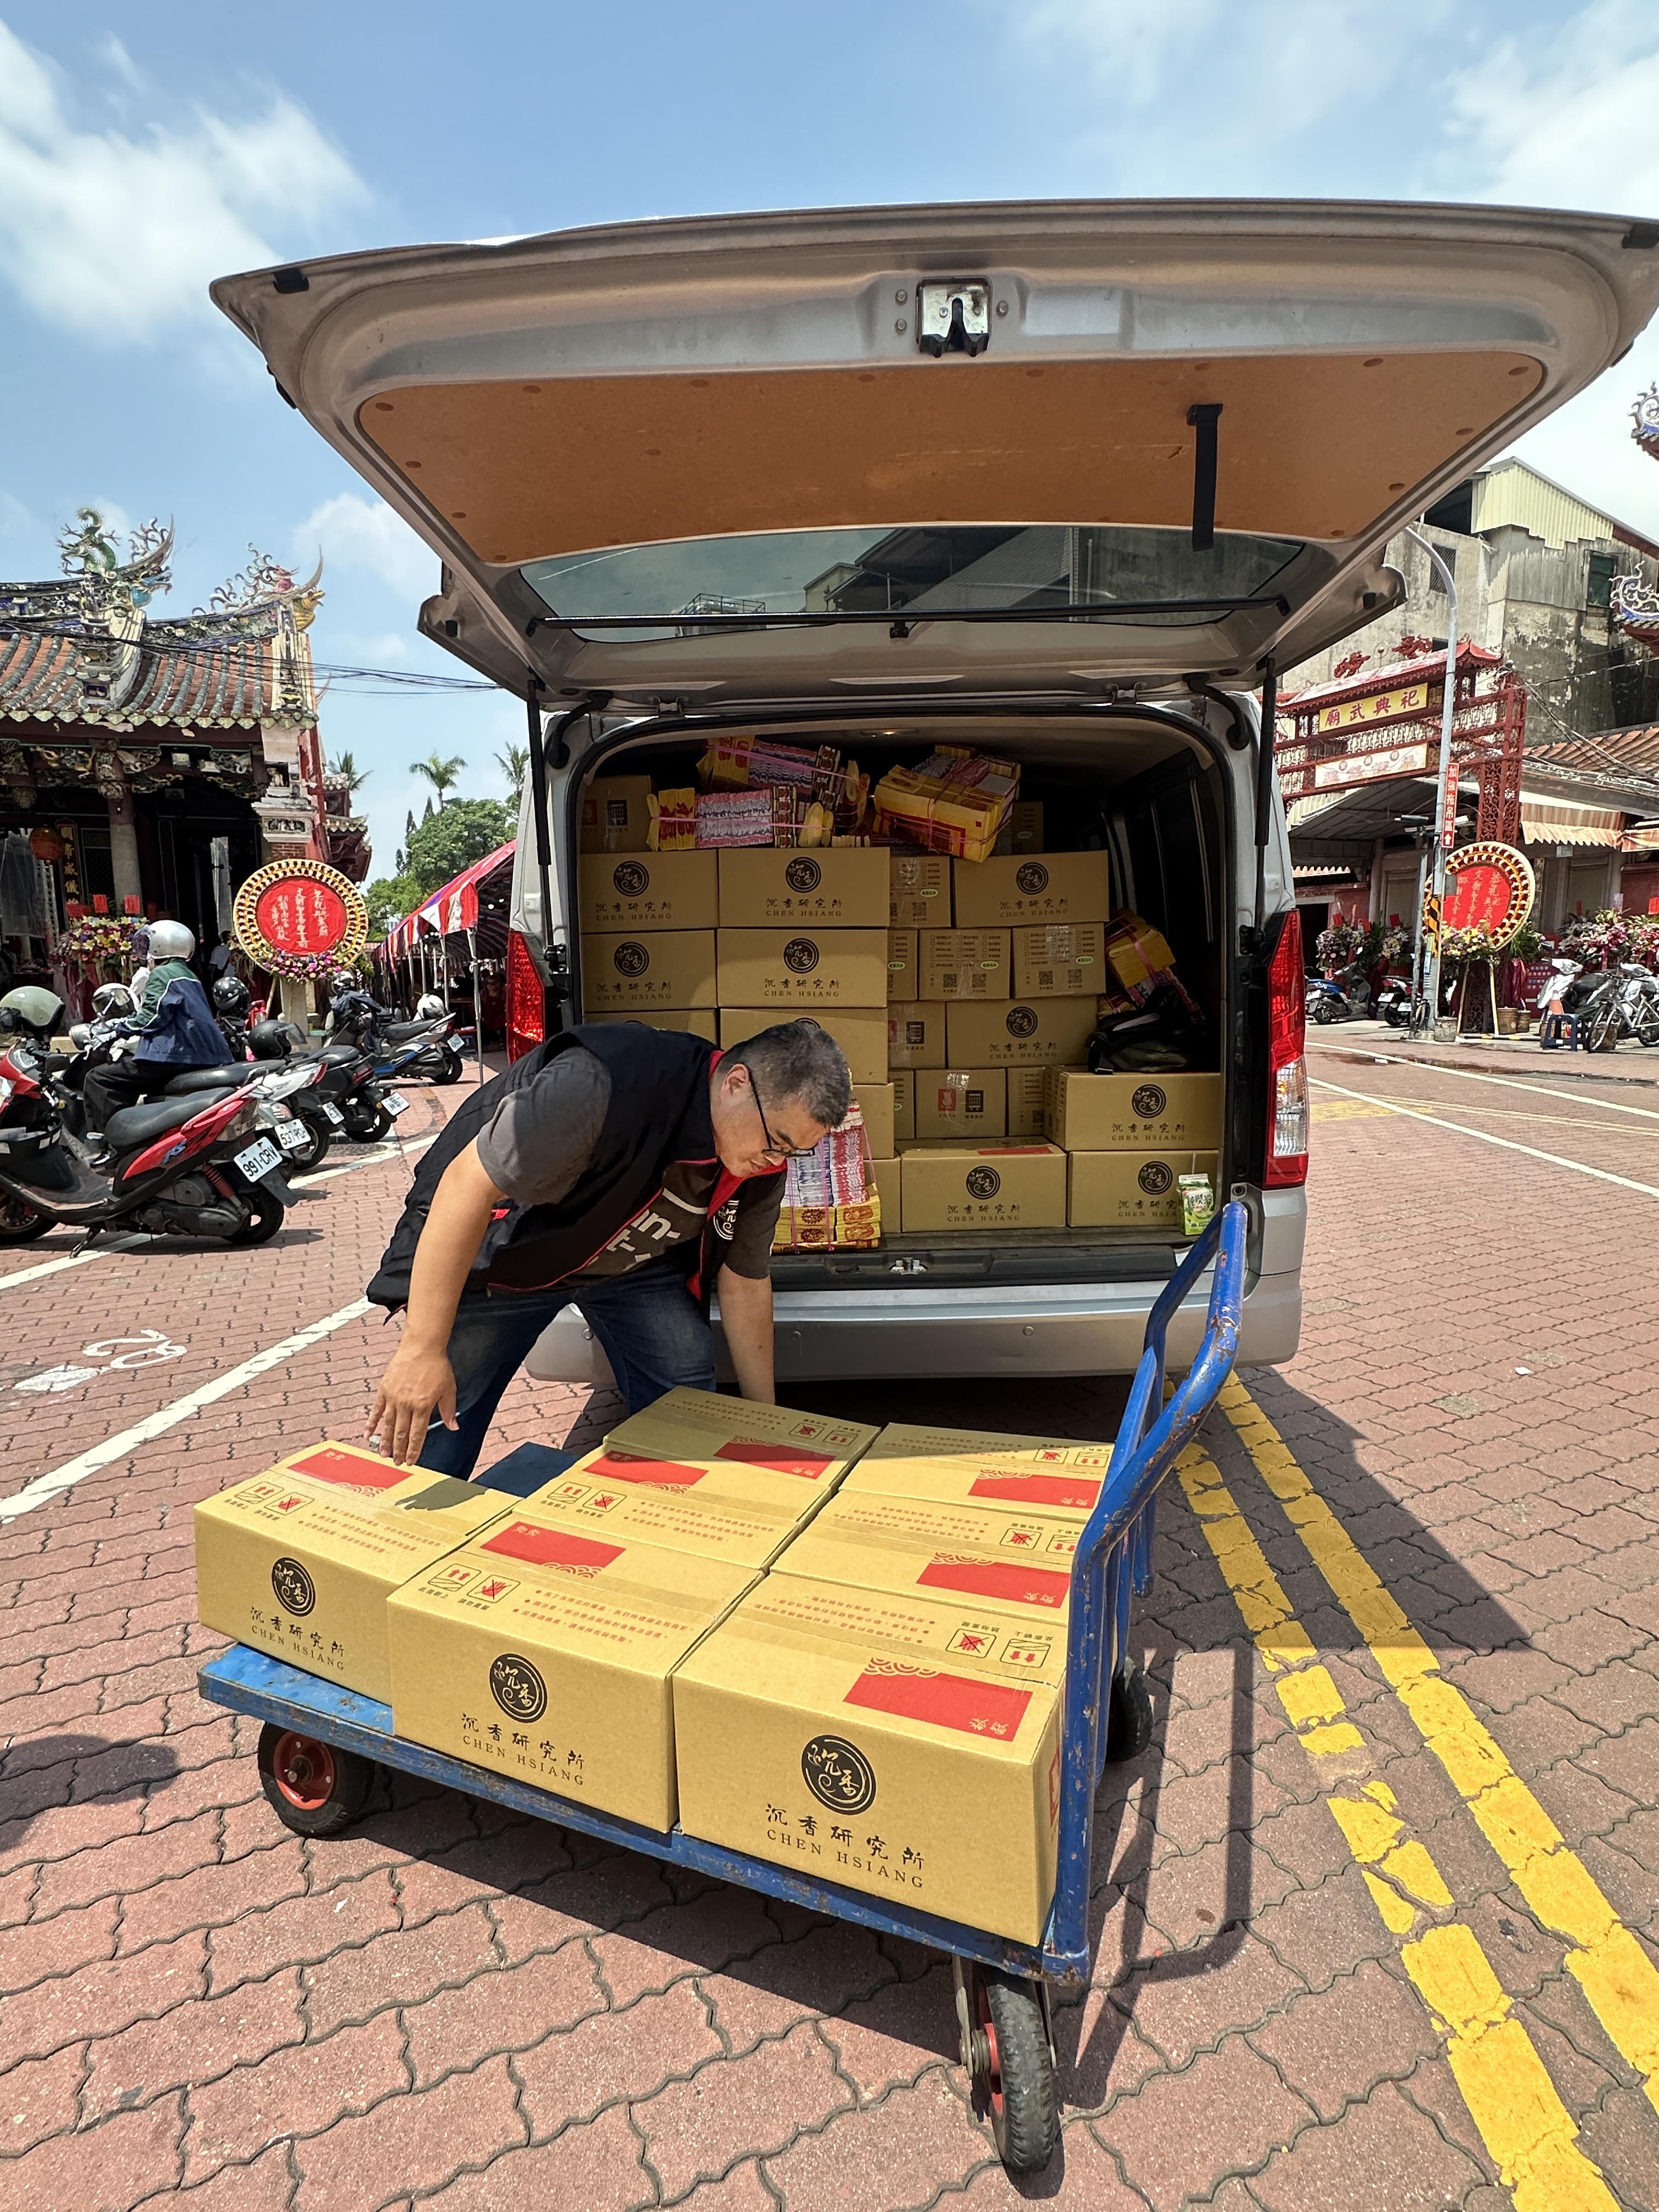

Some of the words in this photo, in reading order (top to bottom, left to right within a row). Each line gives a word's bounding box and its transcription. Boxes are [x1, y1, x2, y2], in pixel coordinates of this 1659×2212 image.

[595, 901, 672, 913] 沉香研究所
[766, 898, 843, 909] 沉香研究所
[1000, 898, 1069, 910] 沉香研究所
[596, 981, 672, 992] 沉香研究所
[764, 978, 839, 989] 沉香研究所
[597, 993, 624, 1001] CHEN
[798, 989, 839, 997] HSIANG
[989, 1041, 1058, 1051] 沉香研究所
[1112, 1123, 1186, 1133] 沉香研究所
[947, 1204, 1020, 1214] 沉香研究所
[250, 1606, 346, 1658] 沉香研究所
[252, 1624, 286, 1647] CHEN
[293, 1643, 346, 1671] HSIANG
[462, 1713, 585, 1767] 沉香研究所
[463, 1735, 506, 1758] CHEN
[517, 1754, 585, 1786] HSIANG
[766, 1803, 925, 1871] 沉香研究所
[767, 1829, 822, 1855] CHEN
[837, 1851, 925, 1889] HSIANG
